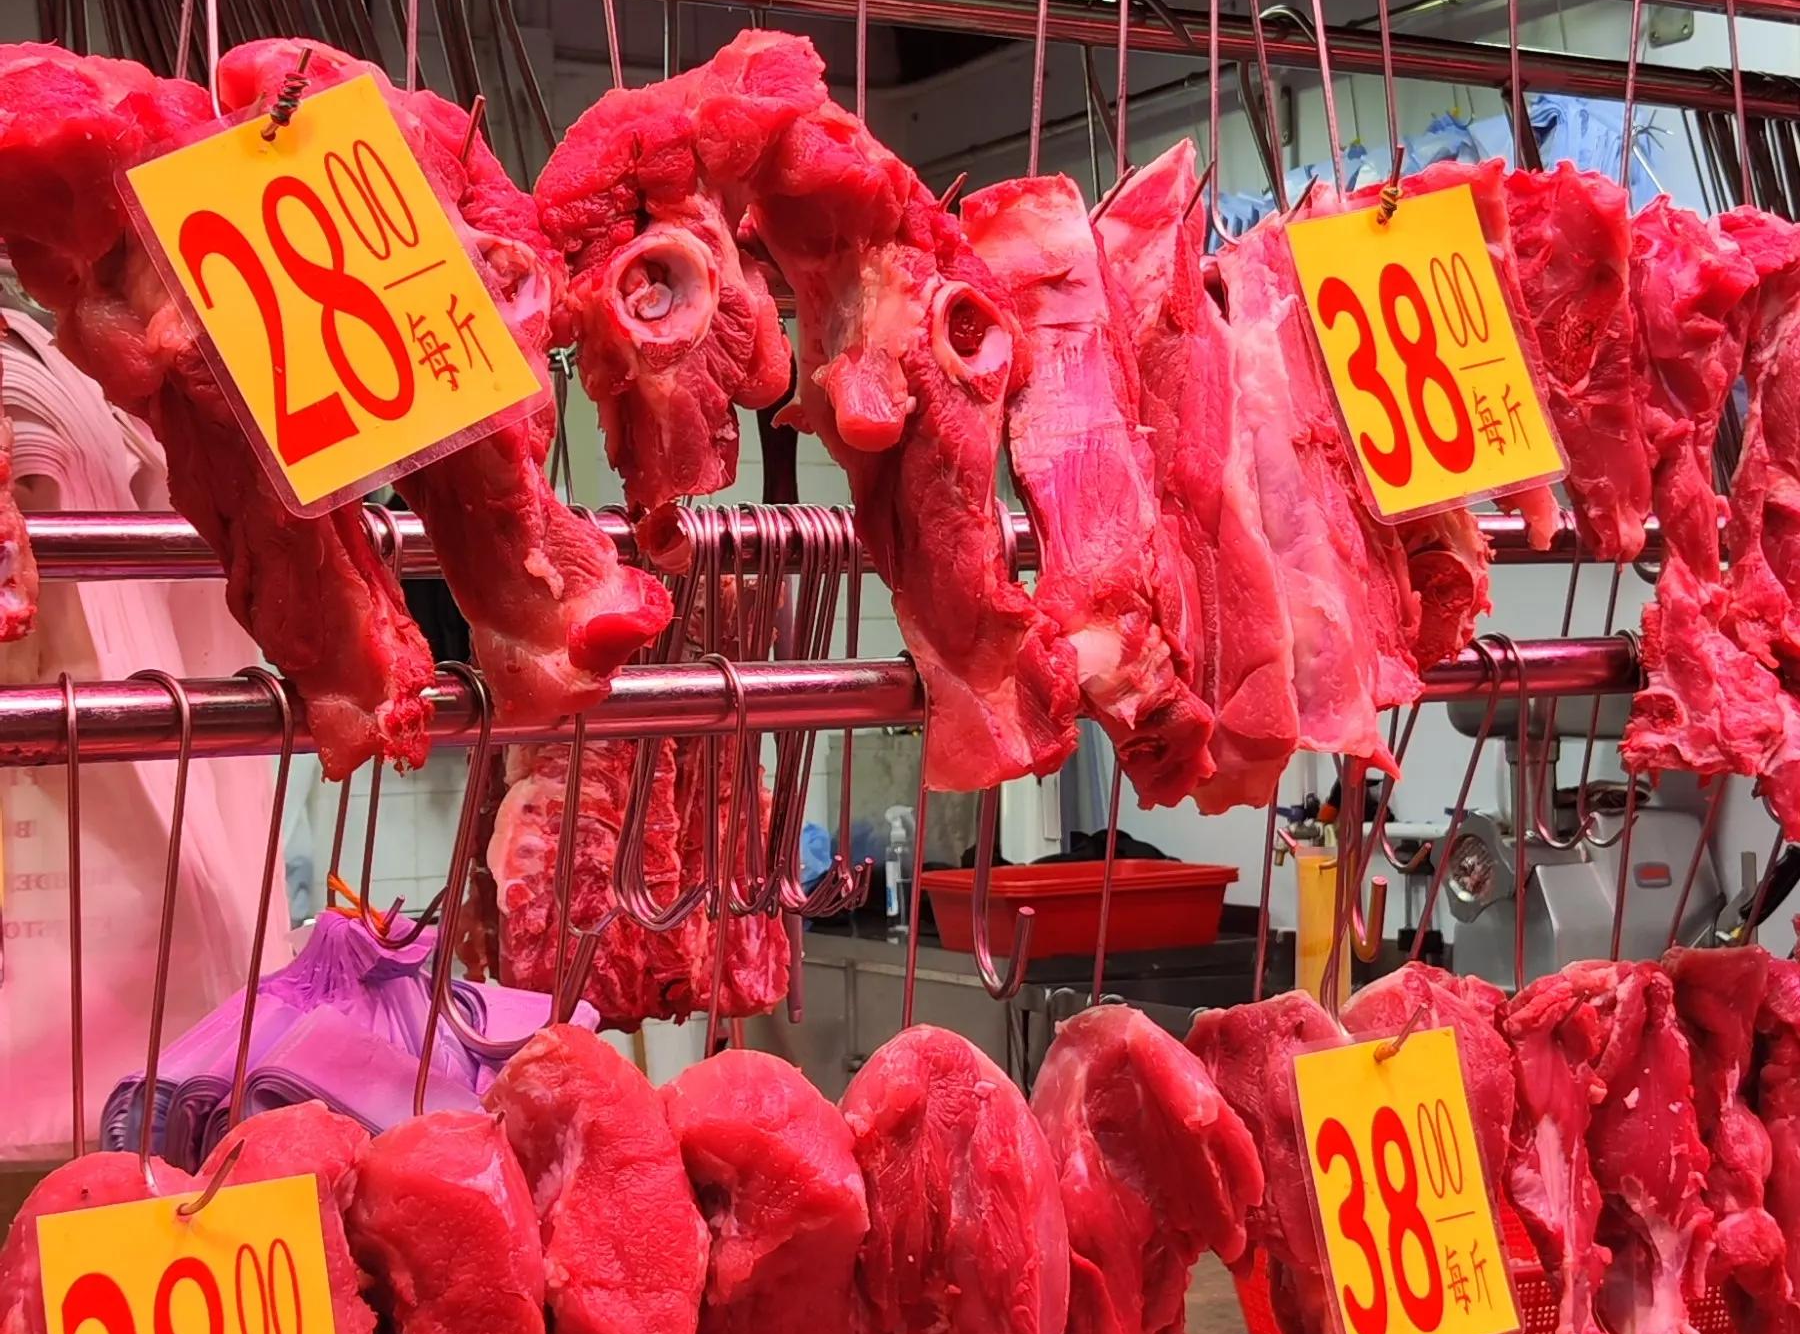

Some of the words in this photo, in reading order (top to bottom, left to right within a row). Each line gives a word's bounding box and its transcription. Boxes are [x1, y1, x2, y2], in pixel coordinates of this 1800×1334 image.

[405, 294, 498, 392] 每斤
[1473, 383, 1531, 456] 每斤
[1446, 1240, 1494, 1316] 每斤
